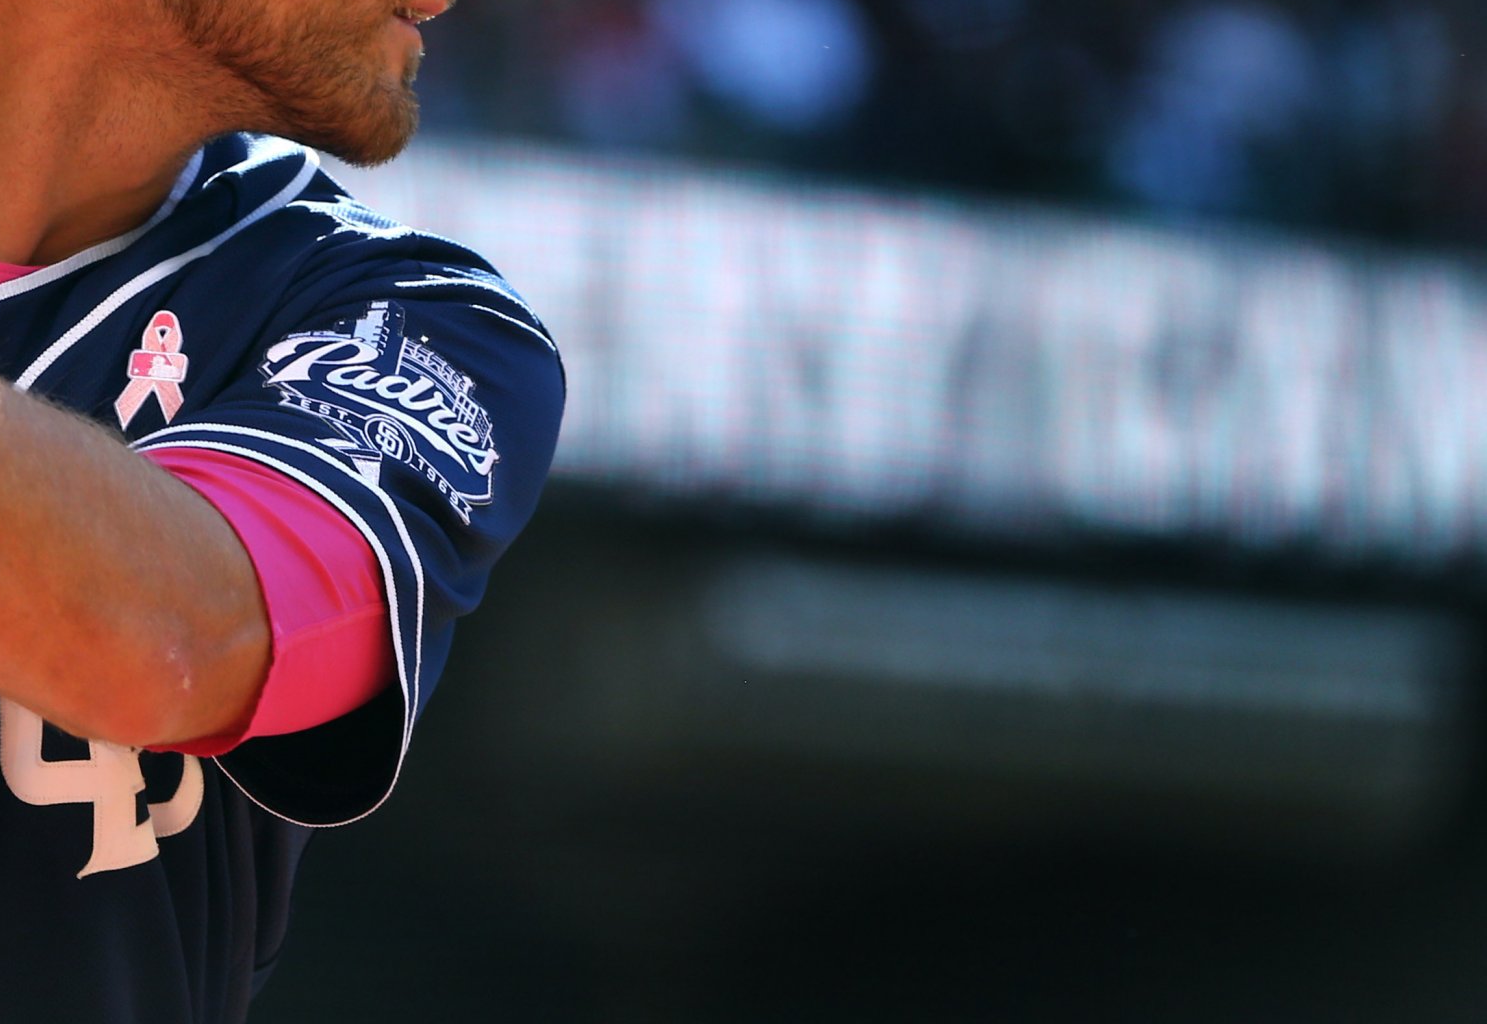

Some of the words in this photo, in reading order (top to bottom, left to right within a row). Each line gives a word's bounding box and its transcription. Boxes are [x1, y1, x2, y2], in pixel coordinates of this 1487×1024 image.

[266, 336, 500, 476] Padres
[300, 398, 352, 424] EST.
[417, 458, 459, 506] 1969
[375, 421, 404, 460] SD
